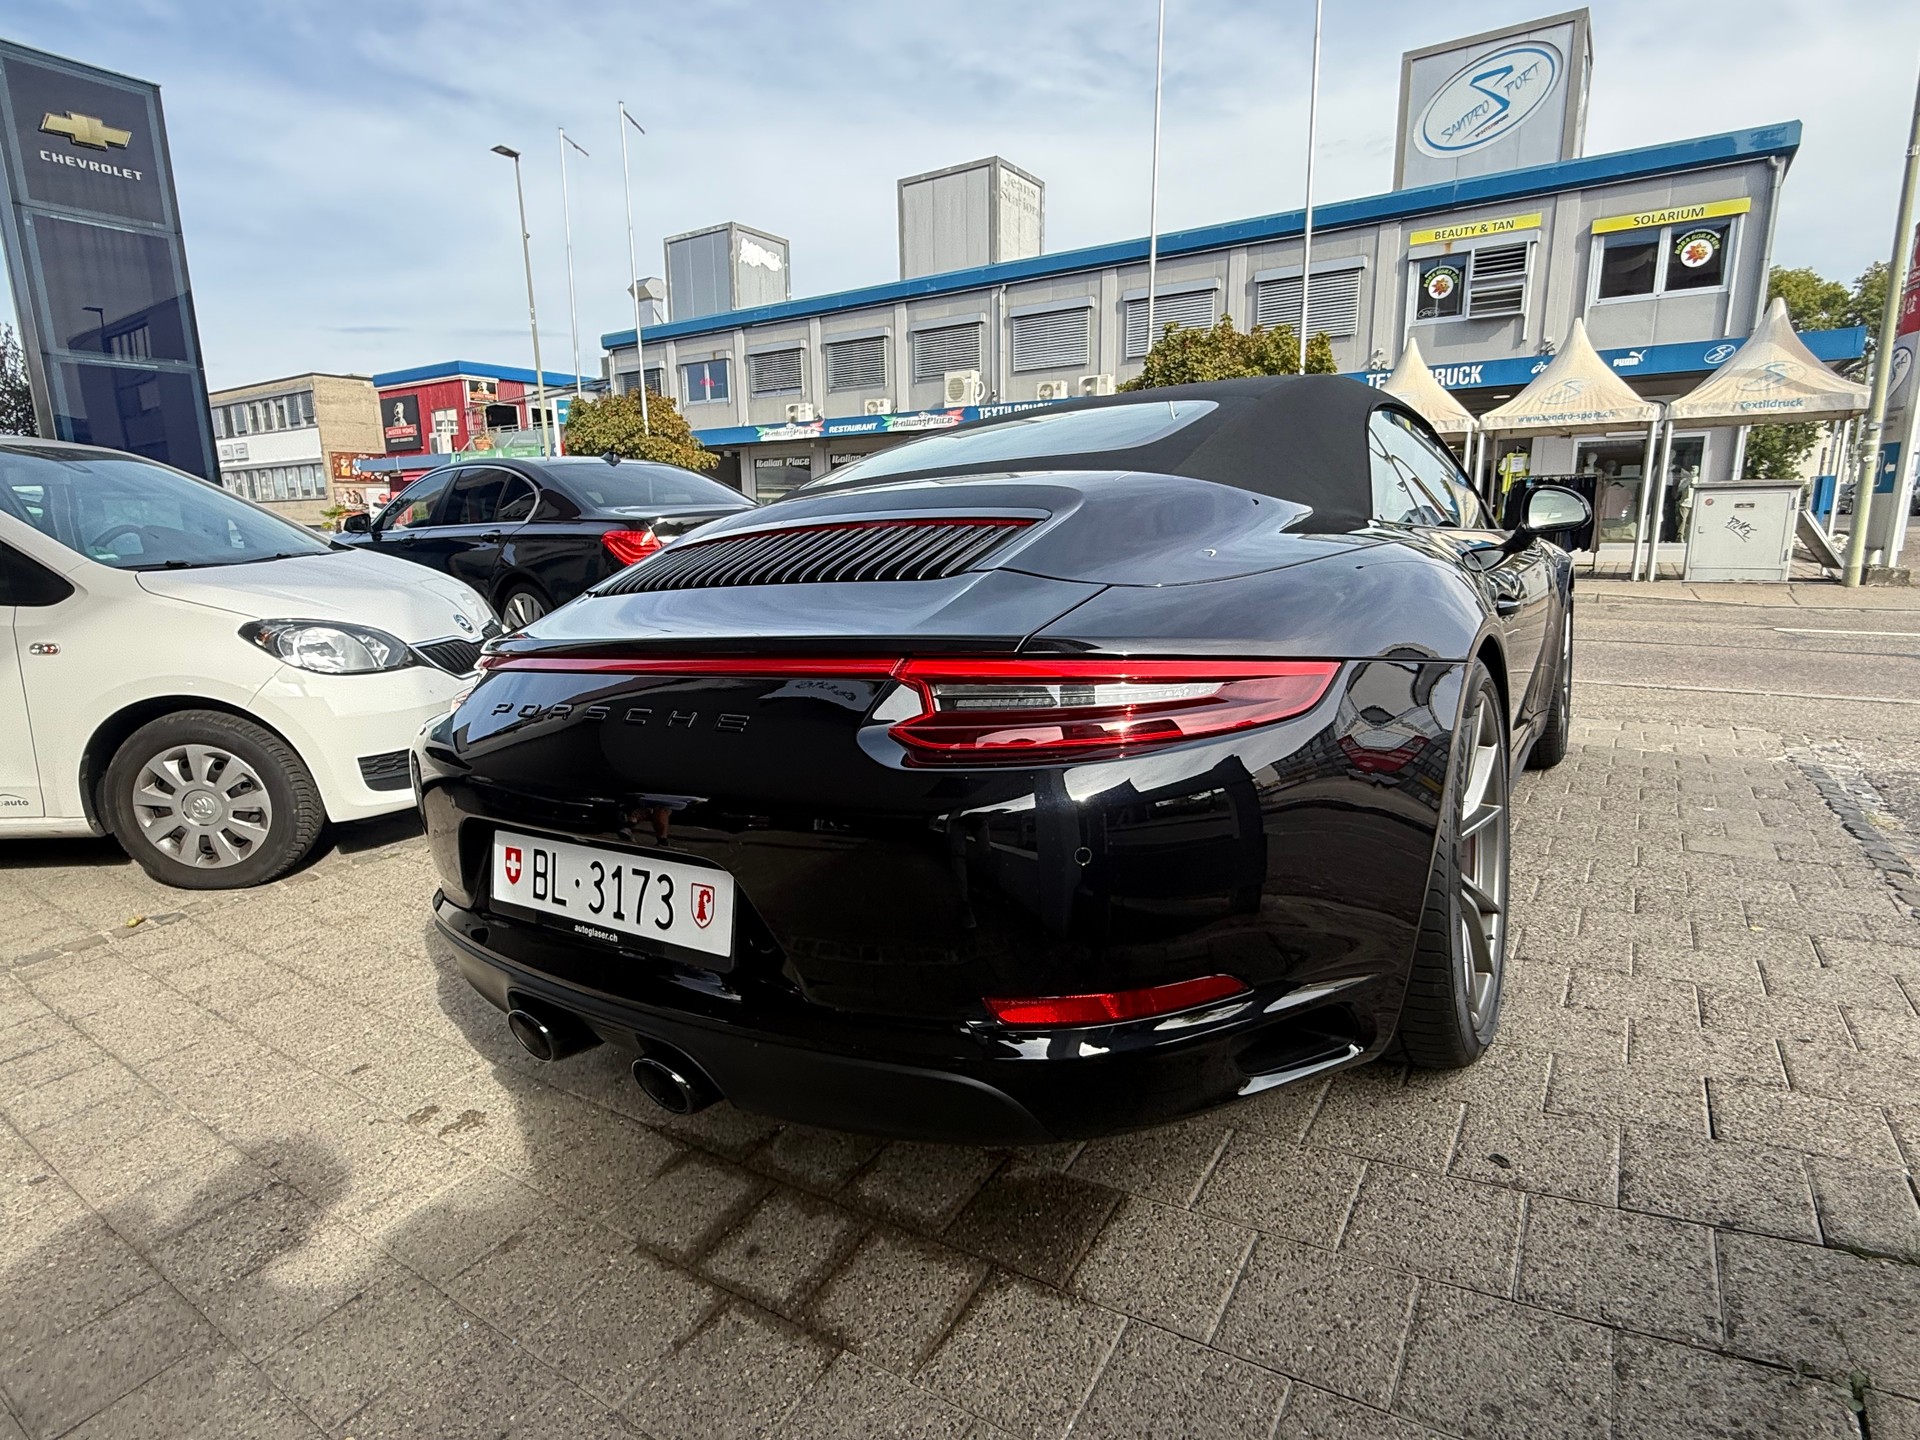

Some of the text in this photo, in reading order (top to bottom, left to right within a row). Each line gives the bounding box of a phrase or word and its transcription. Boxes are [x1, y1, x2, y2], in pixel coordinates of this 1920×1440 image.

[1441, 100, 1490, 143] SANDRO
[40, 150, 142, 181] CHEVROLET
[1002, 172, 1036, 199] Jeans
[1633, 206, 1705, 226] SOLARIUM
[1434, 219, 1515, 240] BEAUTY & TAN
[978, 402, 1053, 420] TEXTIL
[1741, 397, 1804, 412] Textildruck
[926, 415, 953, 426] Place
[1517, 409, 1616, 424] www.sandro-sport.ch
[828, 422, 878, 434] RESTAURANT
[756, 457, 810, 468] Italian Place
[490, 701, 751, 733] PORSCHE
[532, 848, 567, 907] BL
[588, 860, 675, 931] 3173
[574, 922, 618, 943] autoglaser.ch
